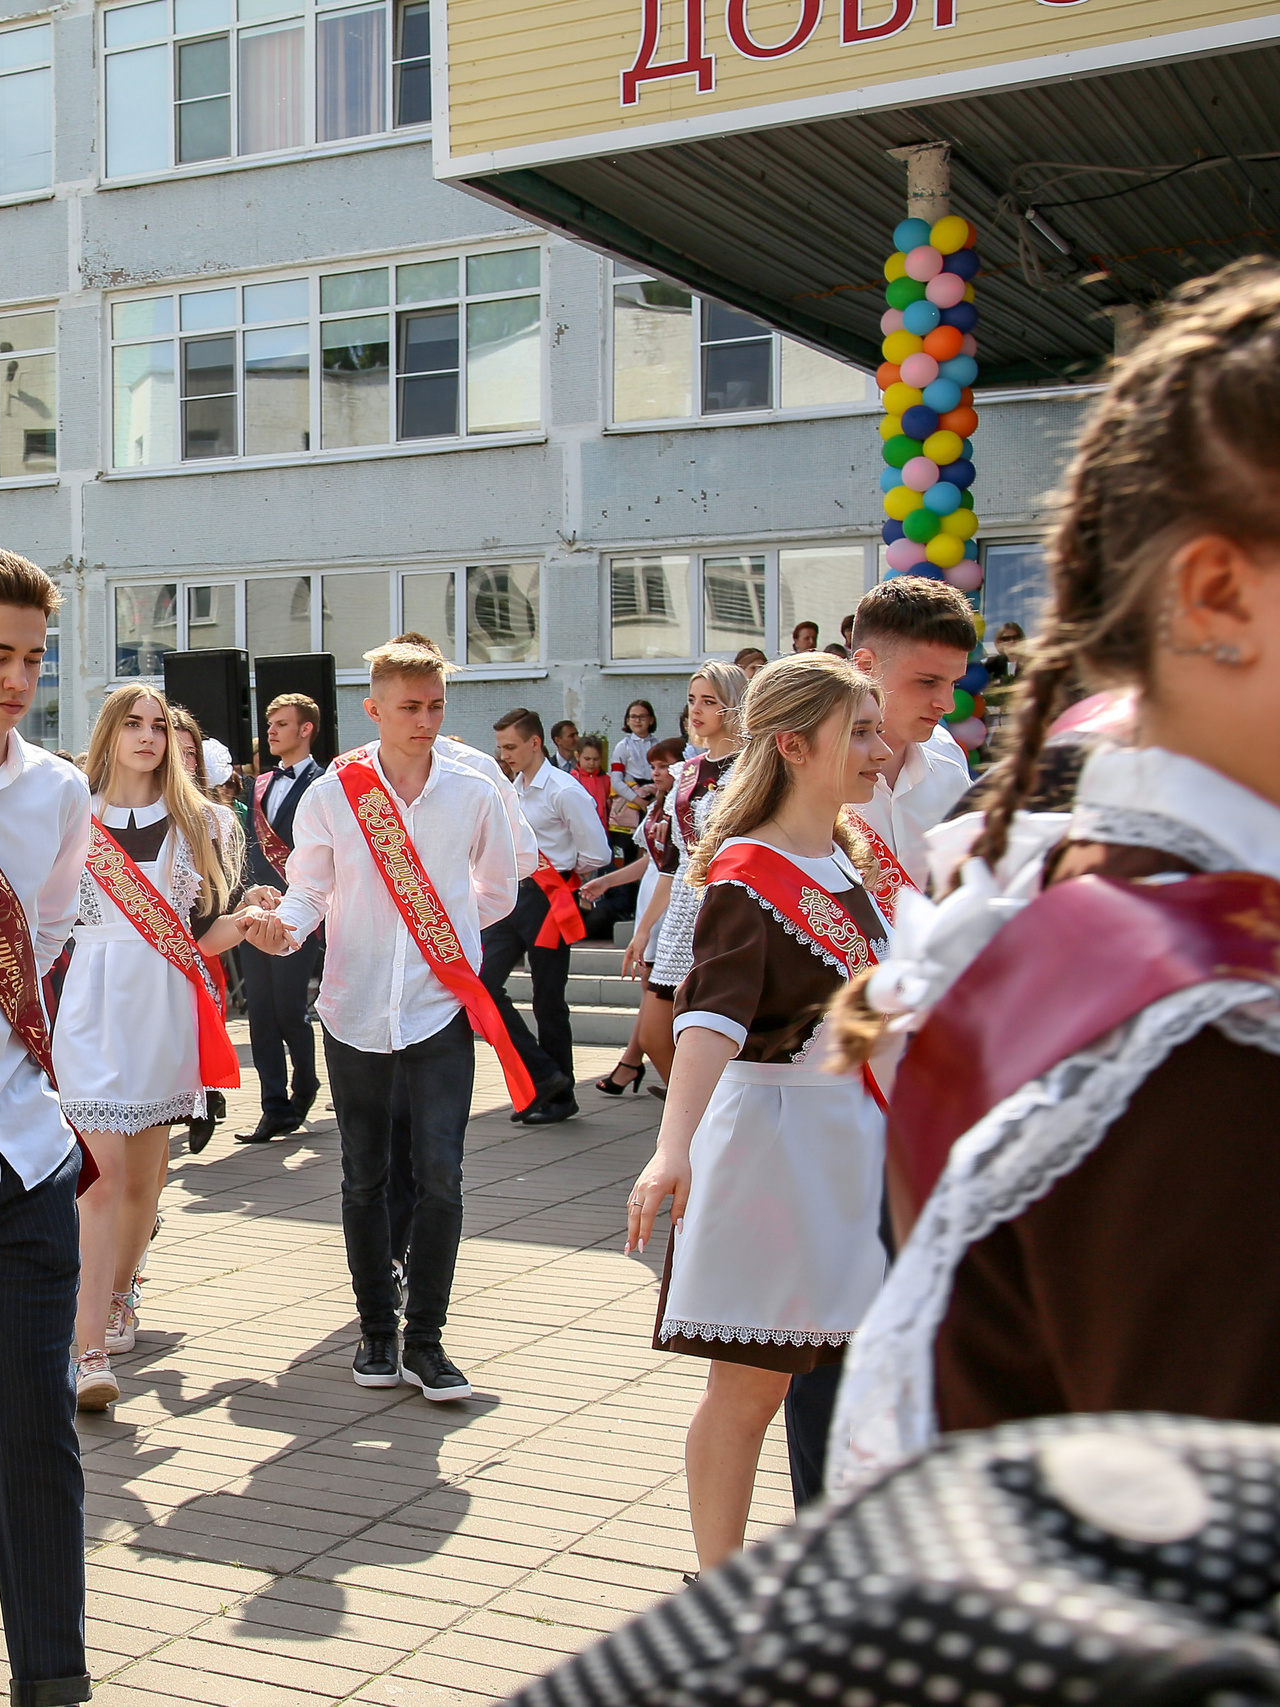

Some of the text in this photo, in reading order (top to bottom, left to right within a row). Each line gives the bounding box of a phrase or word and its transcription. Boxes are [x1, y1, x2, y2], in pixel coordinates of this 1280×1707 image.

[87, 845, 194, 970] Выпускник 2021
[365, 818, 463, 963] Выпускник 2021
